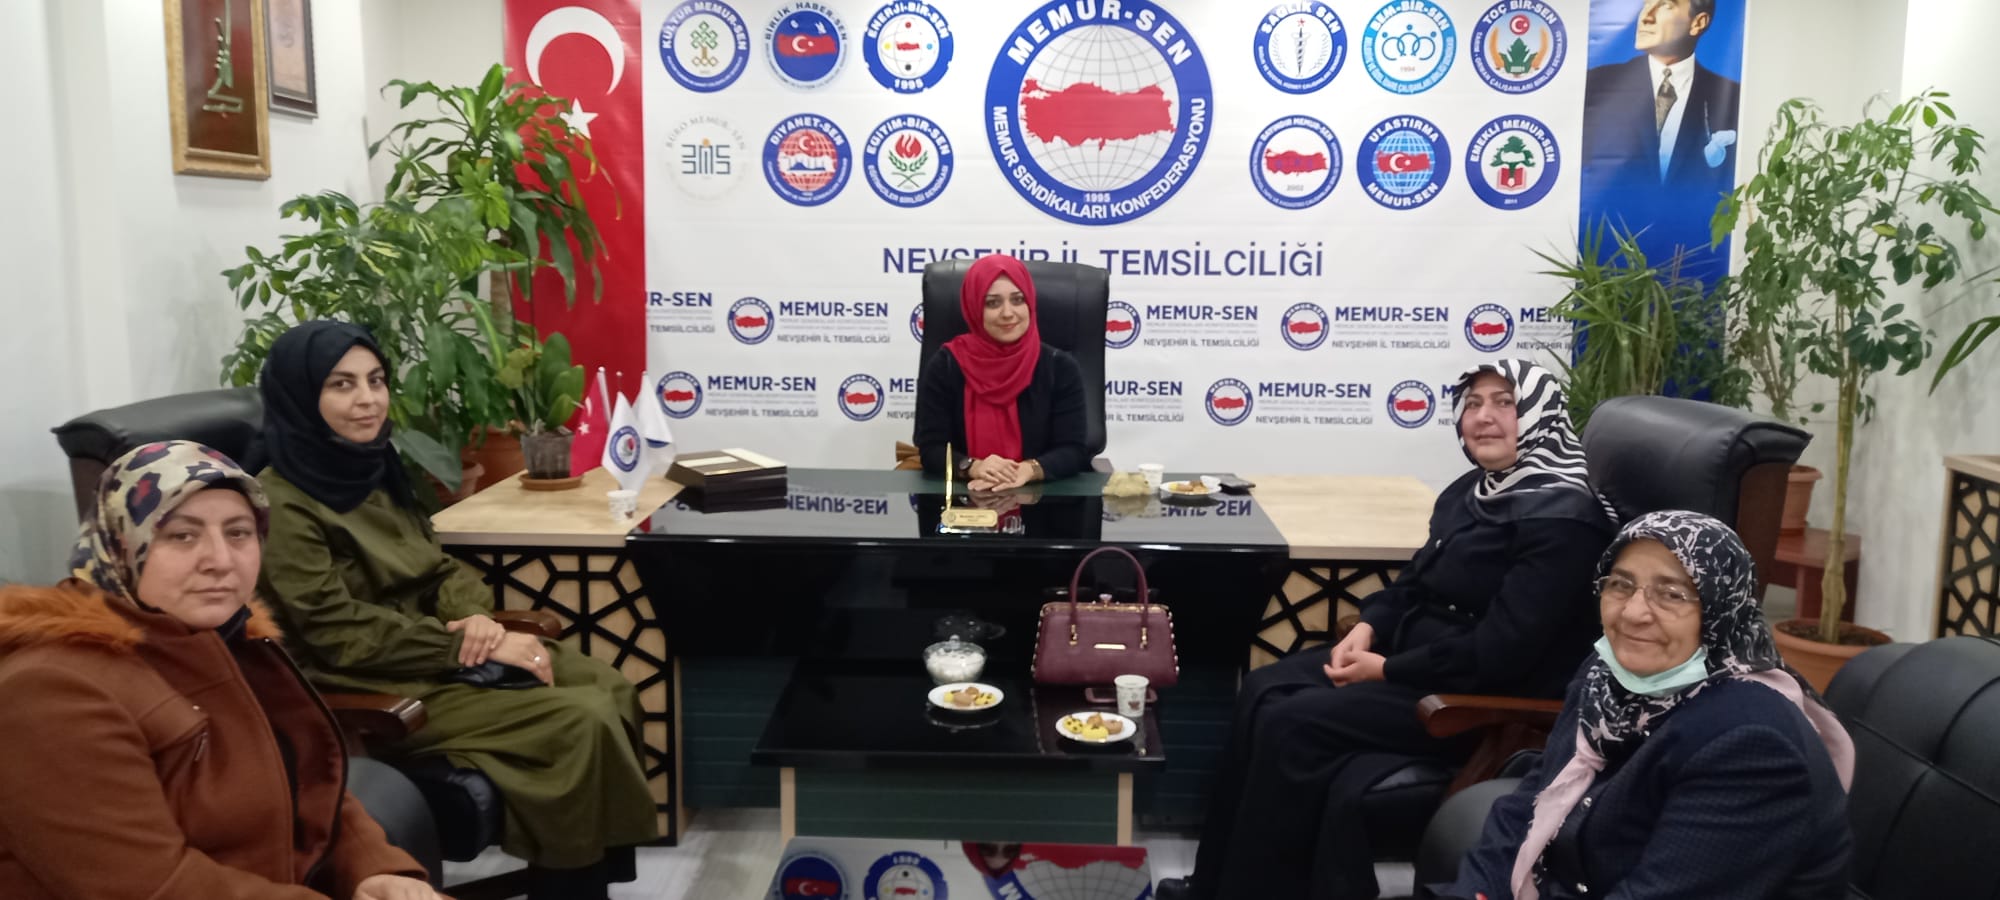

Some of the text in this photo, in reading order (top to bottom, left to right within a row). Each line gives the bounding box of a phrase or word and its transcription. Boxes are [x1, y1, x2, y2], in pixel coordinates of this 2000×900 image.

[993, 105, 1020, 168] MEMUR
[1012, 164, 1107, 219] SENDİKALARI
[1110, 97, 1206, 218] KONFEDERASYONU
[1100, 241, 1323, 276] TEMSİLCİLİĞİ
[649, 292, 712, 307] R-SEN
[779, 301, 888, 317] MEMUR-SEN
[1146, 305, 1258, 320] MEMUR-SEN
[1335, 306, 1449, 322] MEMUR-SEN
[707, 376, 816, 391] MEMUR-SEN
[1258, 382, 1371, 398] MEMUR-SEN
